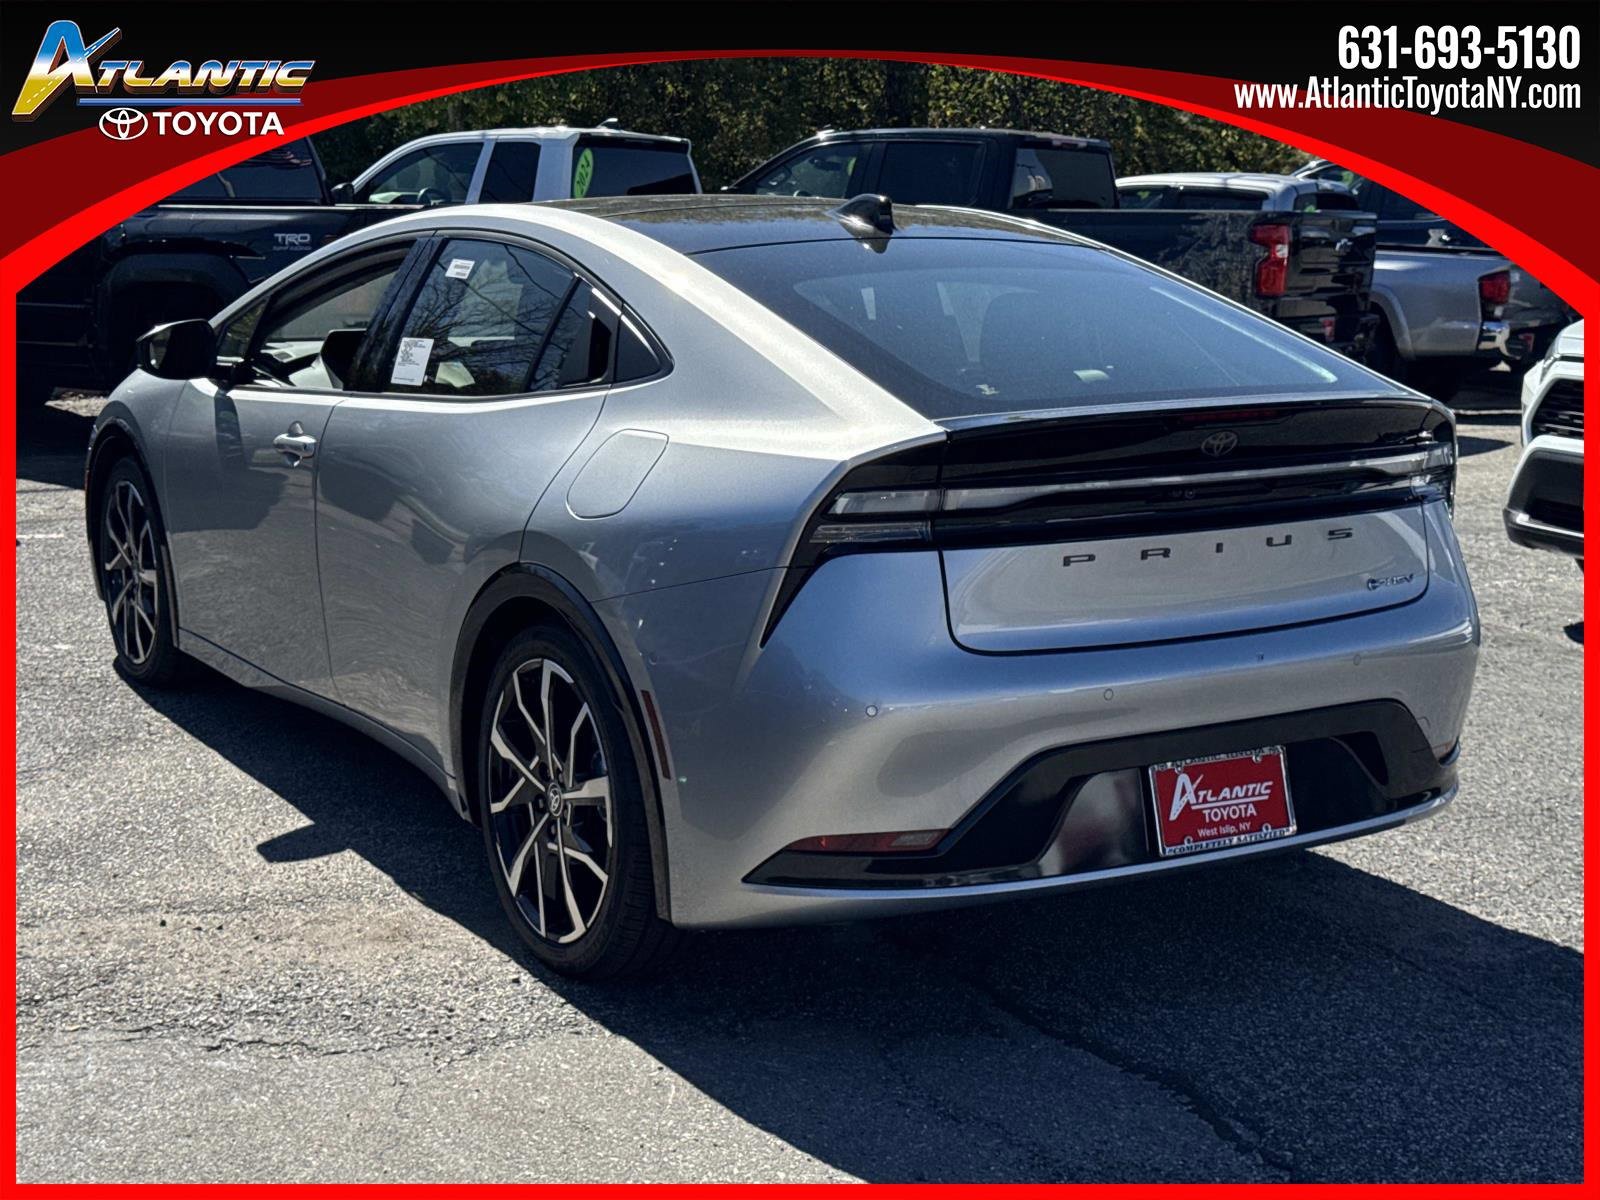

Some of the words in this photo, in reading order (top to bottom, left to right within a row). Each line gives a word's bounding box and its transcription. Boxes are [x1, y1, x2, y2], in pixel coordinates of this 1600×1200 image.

[1063, 528, 1353, 567] PRIUS
[1169, 773, 1273, 821] ATLANTIC
[1202, 803, 1258, 823] TOYOTA
[1197, 827, 1218, 837] West
[1219, 824, 1238, 835] Islip,
[1239, 822, 1252, 832] NY
